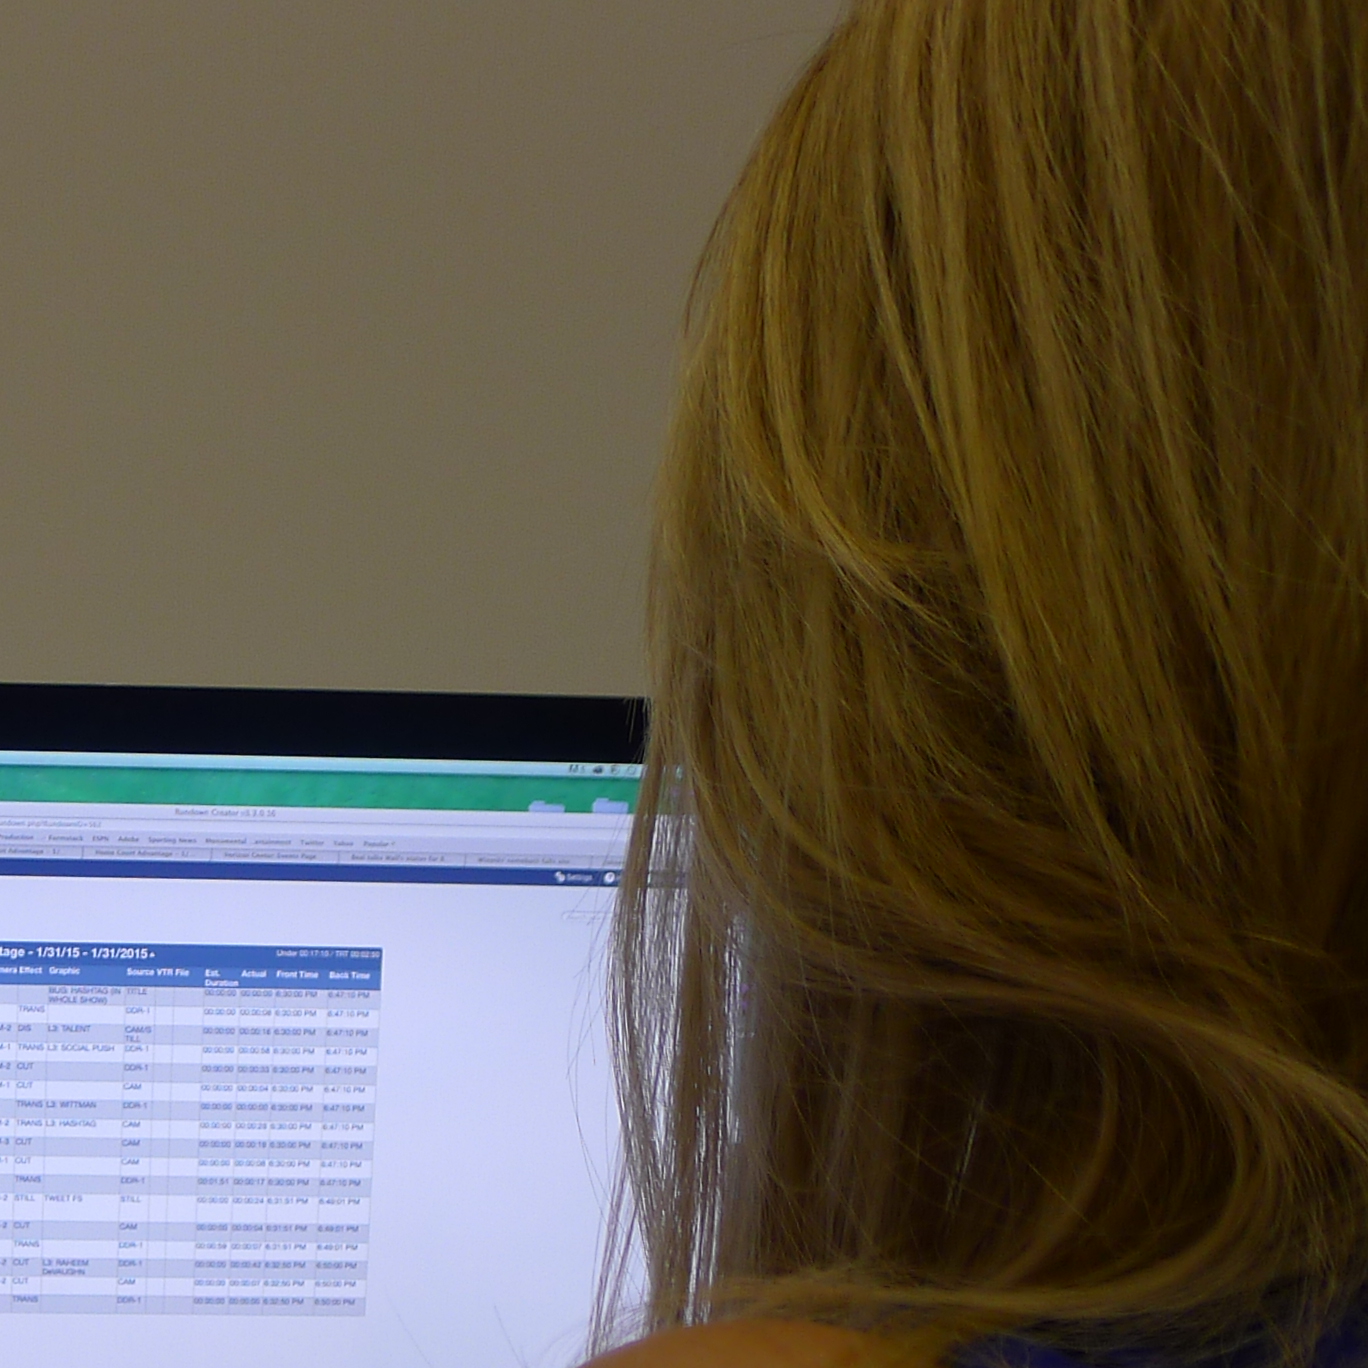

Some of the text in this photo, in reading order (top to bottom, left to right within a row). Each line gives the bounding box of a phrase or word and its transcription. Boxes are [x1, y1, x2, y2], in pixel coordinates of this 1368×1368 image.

[35, 947, 80, 959] 1/31/15
[90, 947, 148, 960] 1/31/2015
[19, 966, 42, 976] Effect
[49, 966, 80, 976] Graphic
[126, 968, 154, 978] Source
[241, 969, 267, 979] Actual
[276, 970, 298, 979] Front
[300, 970, 319, 980] Time
[329, 970, 349, 980] Back
[350, 971, 370, 981] Time
